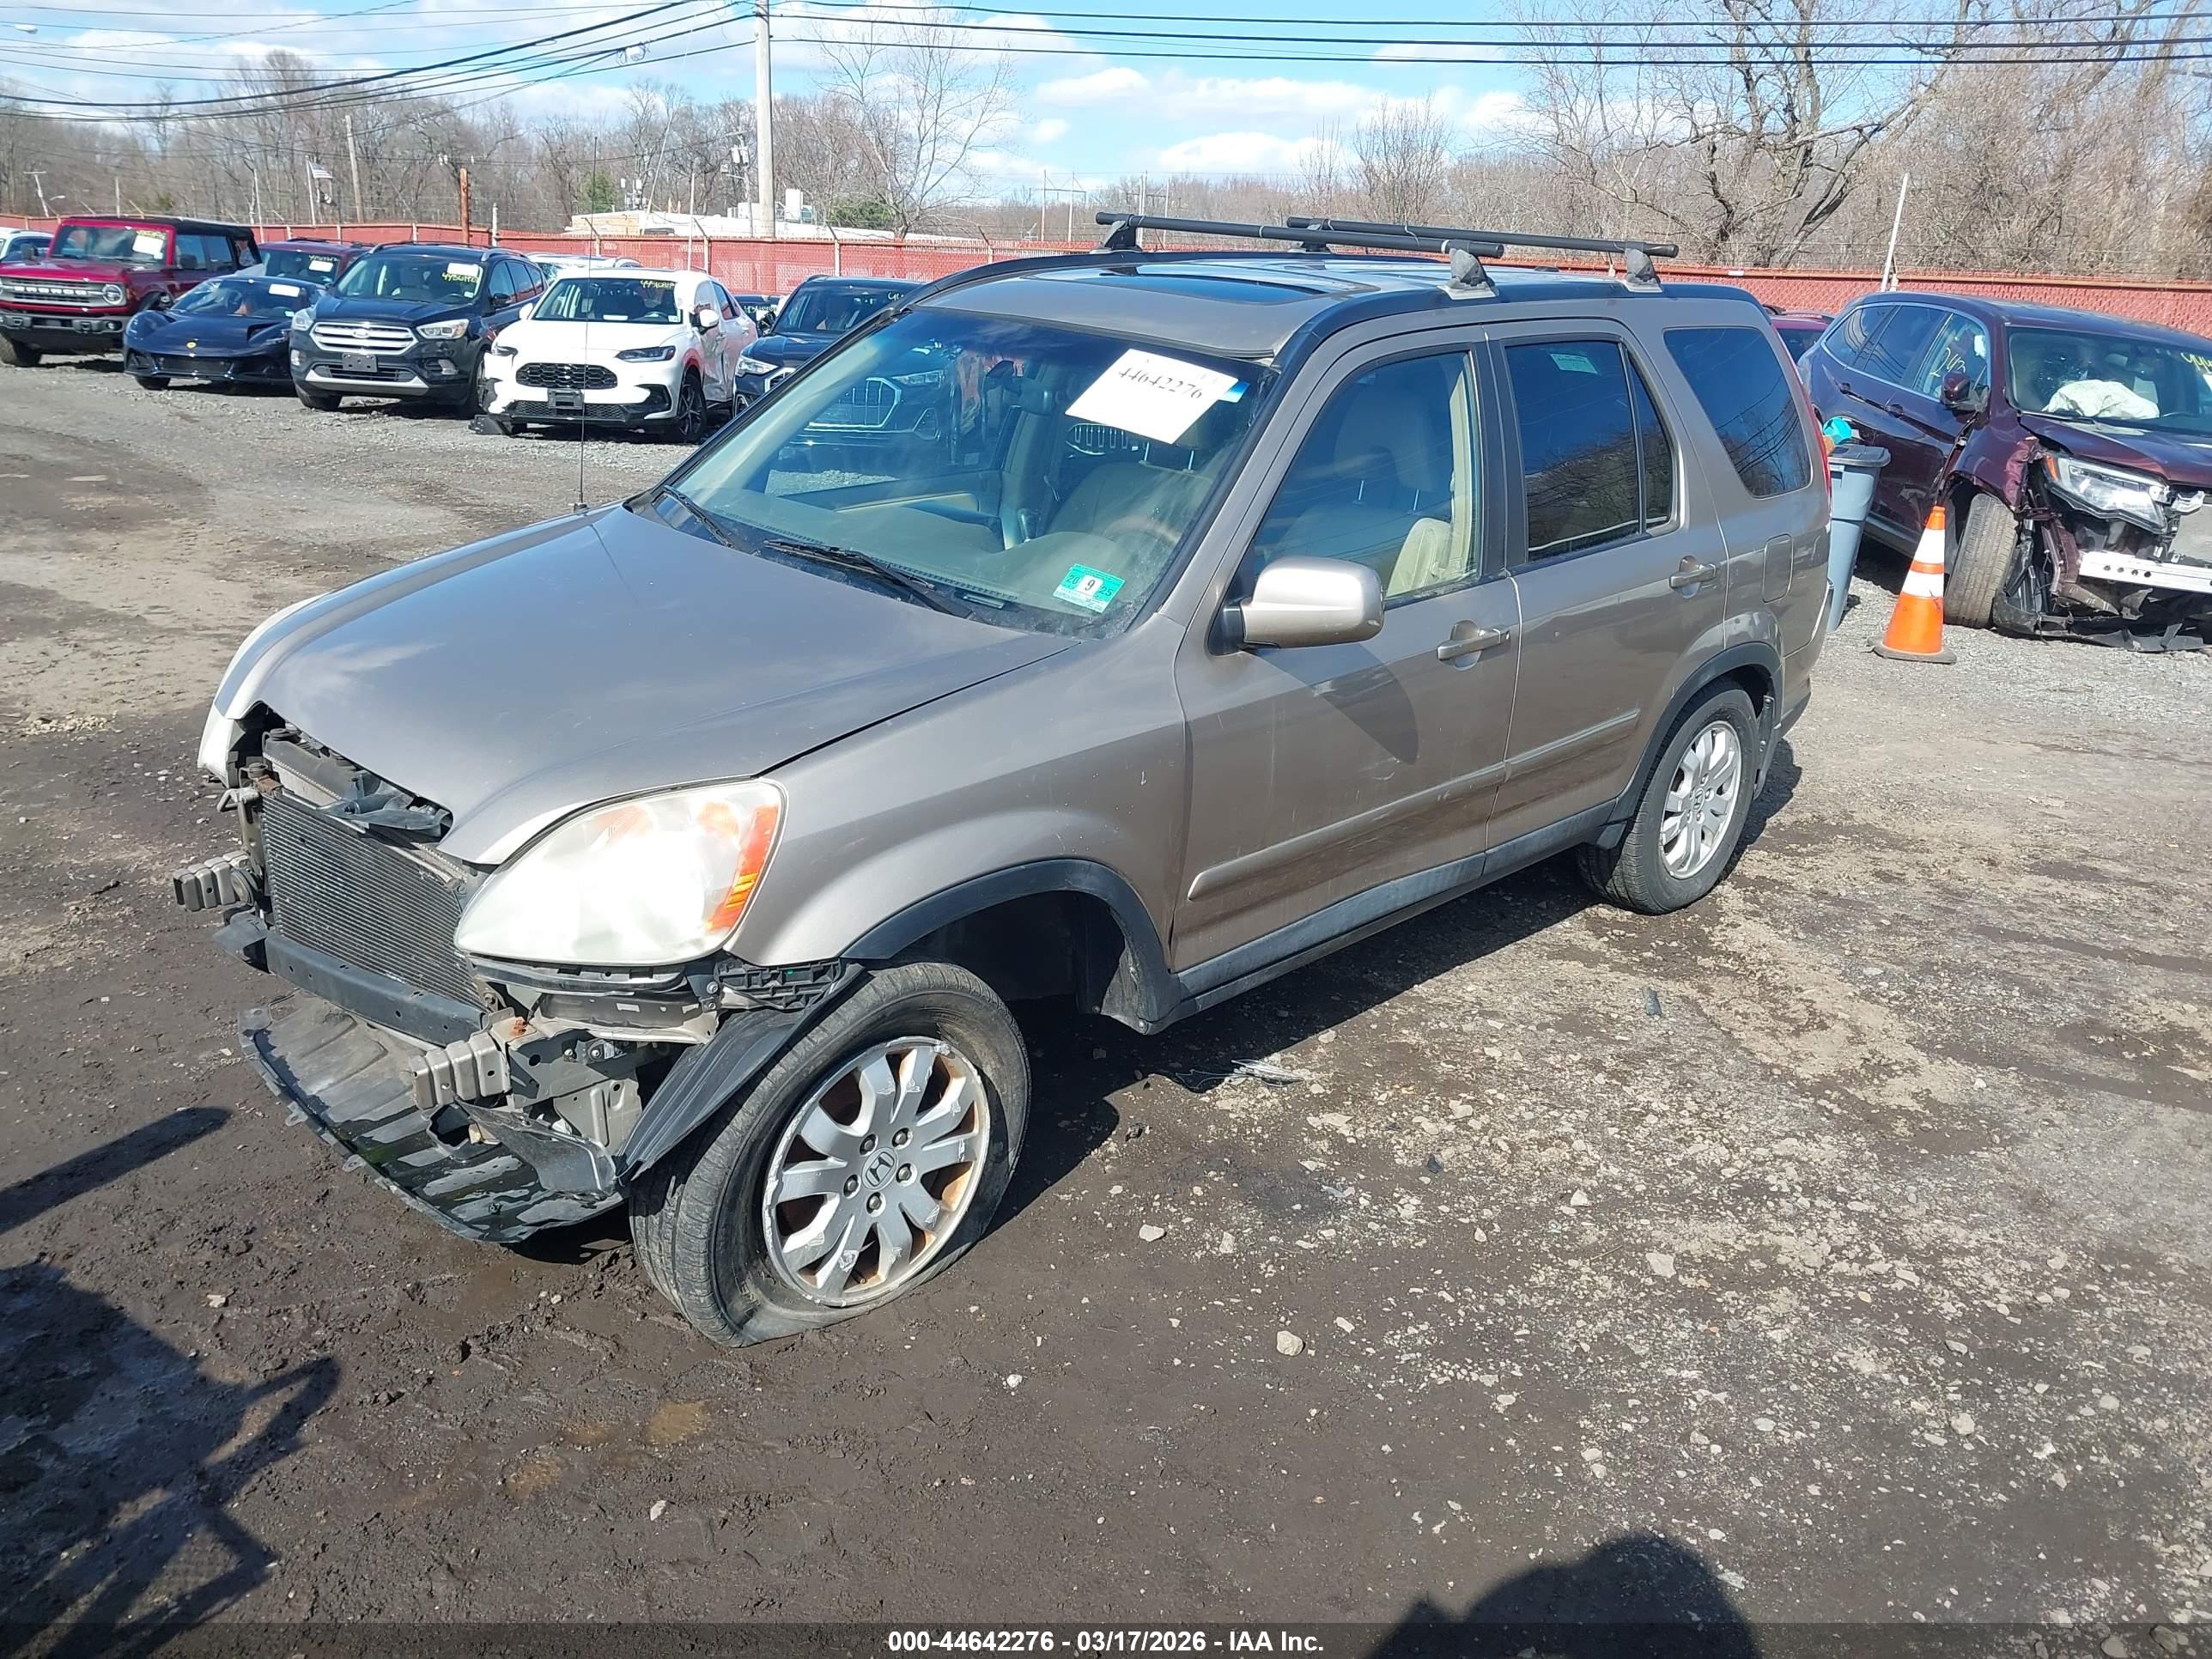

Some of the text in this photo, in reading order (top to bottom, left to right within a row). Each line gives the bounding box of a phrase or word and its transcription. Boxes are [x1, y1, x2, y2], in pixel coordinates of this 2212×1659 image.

[1118, 367, 1203, 399] 44642276
[1066, 574, 1080, 585] 20
[1085, 579, 1096, 592] 9
[1098, 586, 1114, 597] 25
